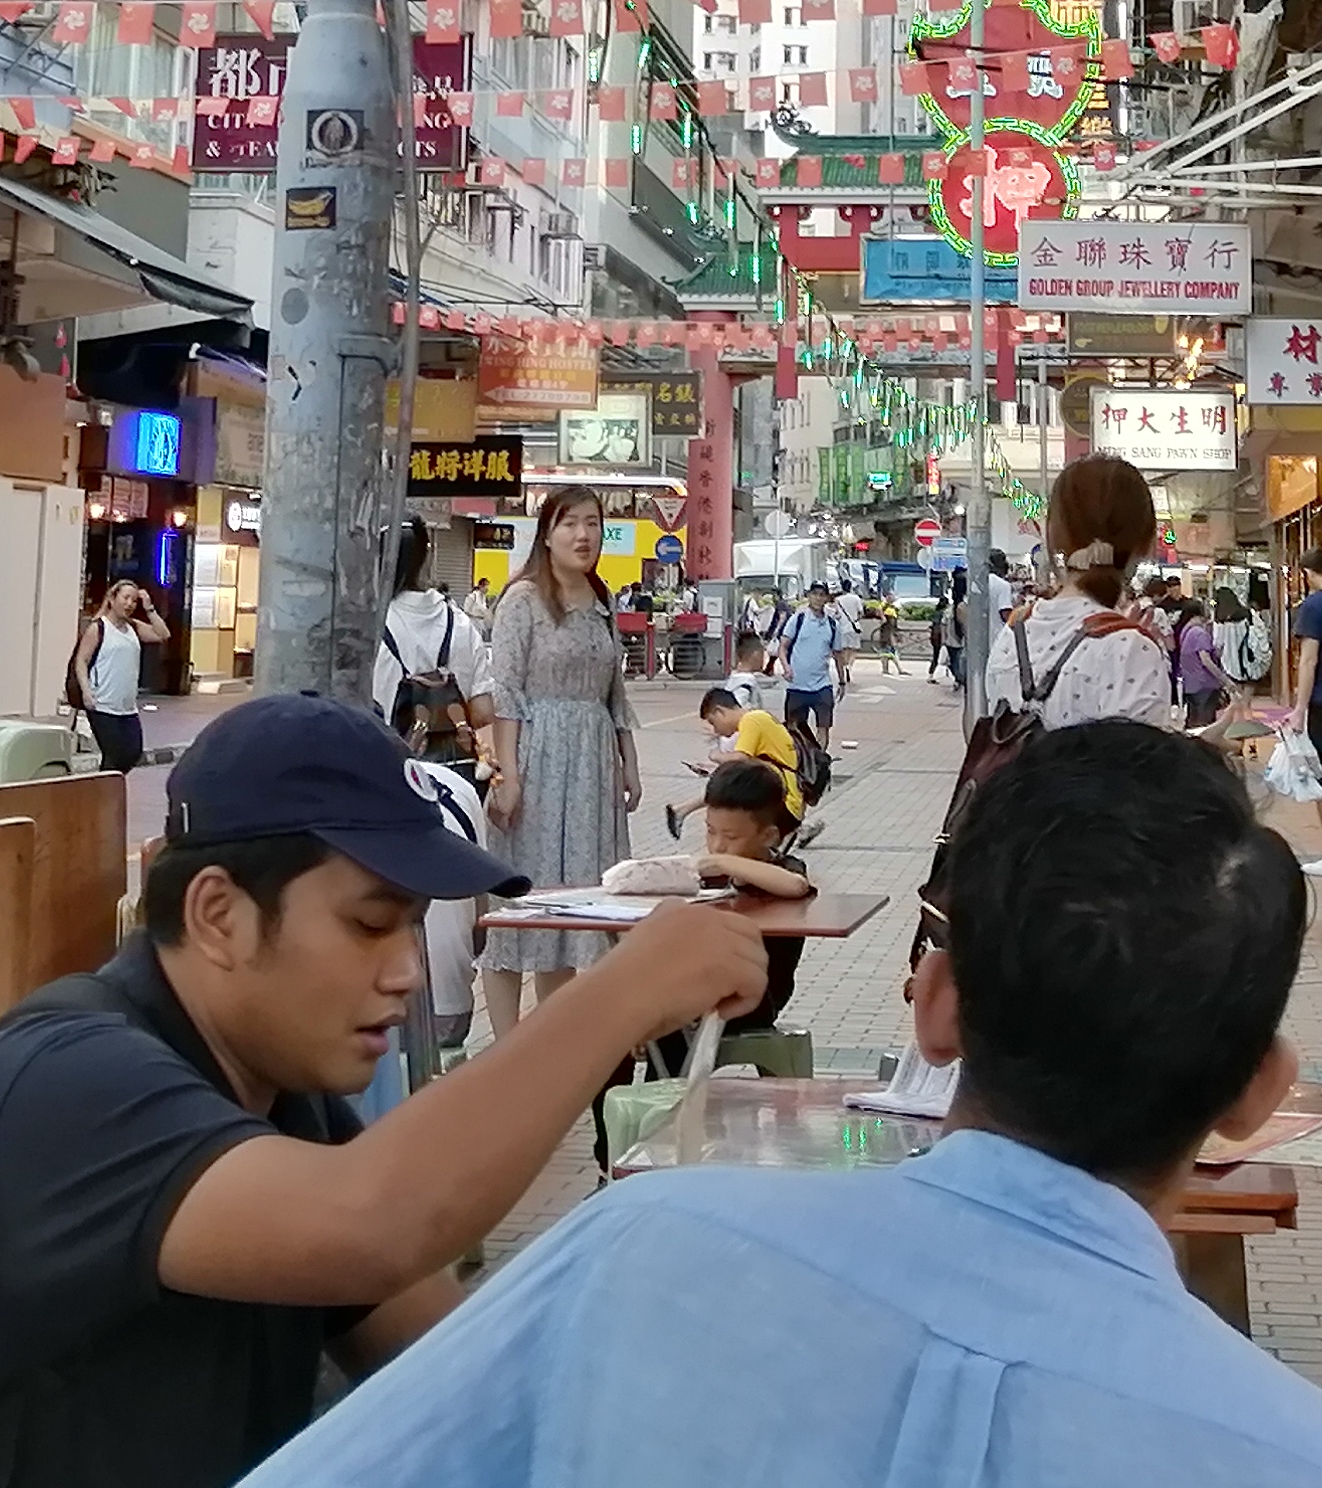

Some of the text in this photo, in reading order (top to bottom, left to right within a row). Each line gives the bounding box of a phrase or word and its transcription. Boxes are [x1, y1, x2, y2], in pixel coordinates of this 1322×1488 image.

[1030, 235, 1240, 275] 金聯珠寶行
[1029, 278, 1073, 296] GOLDEN
[1076, 279, 1114, 297] GROUP
[1118, 280, 1181, 299] JEWELLERY
[1184, 281, 1241, 300] COMPANY
